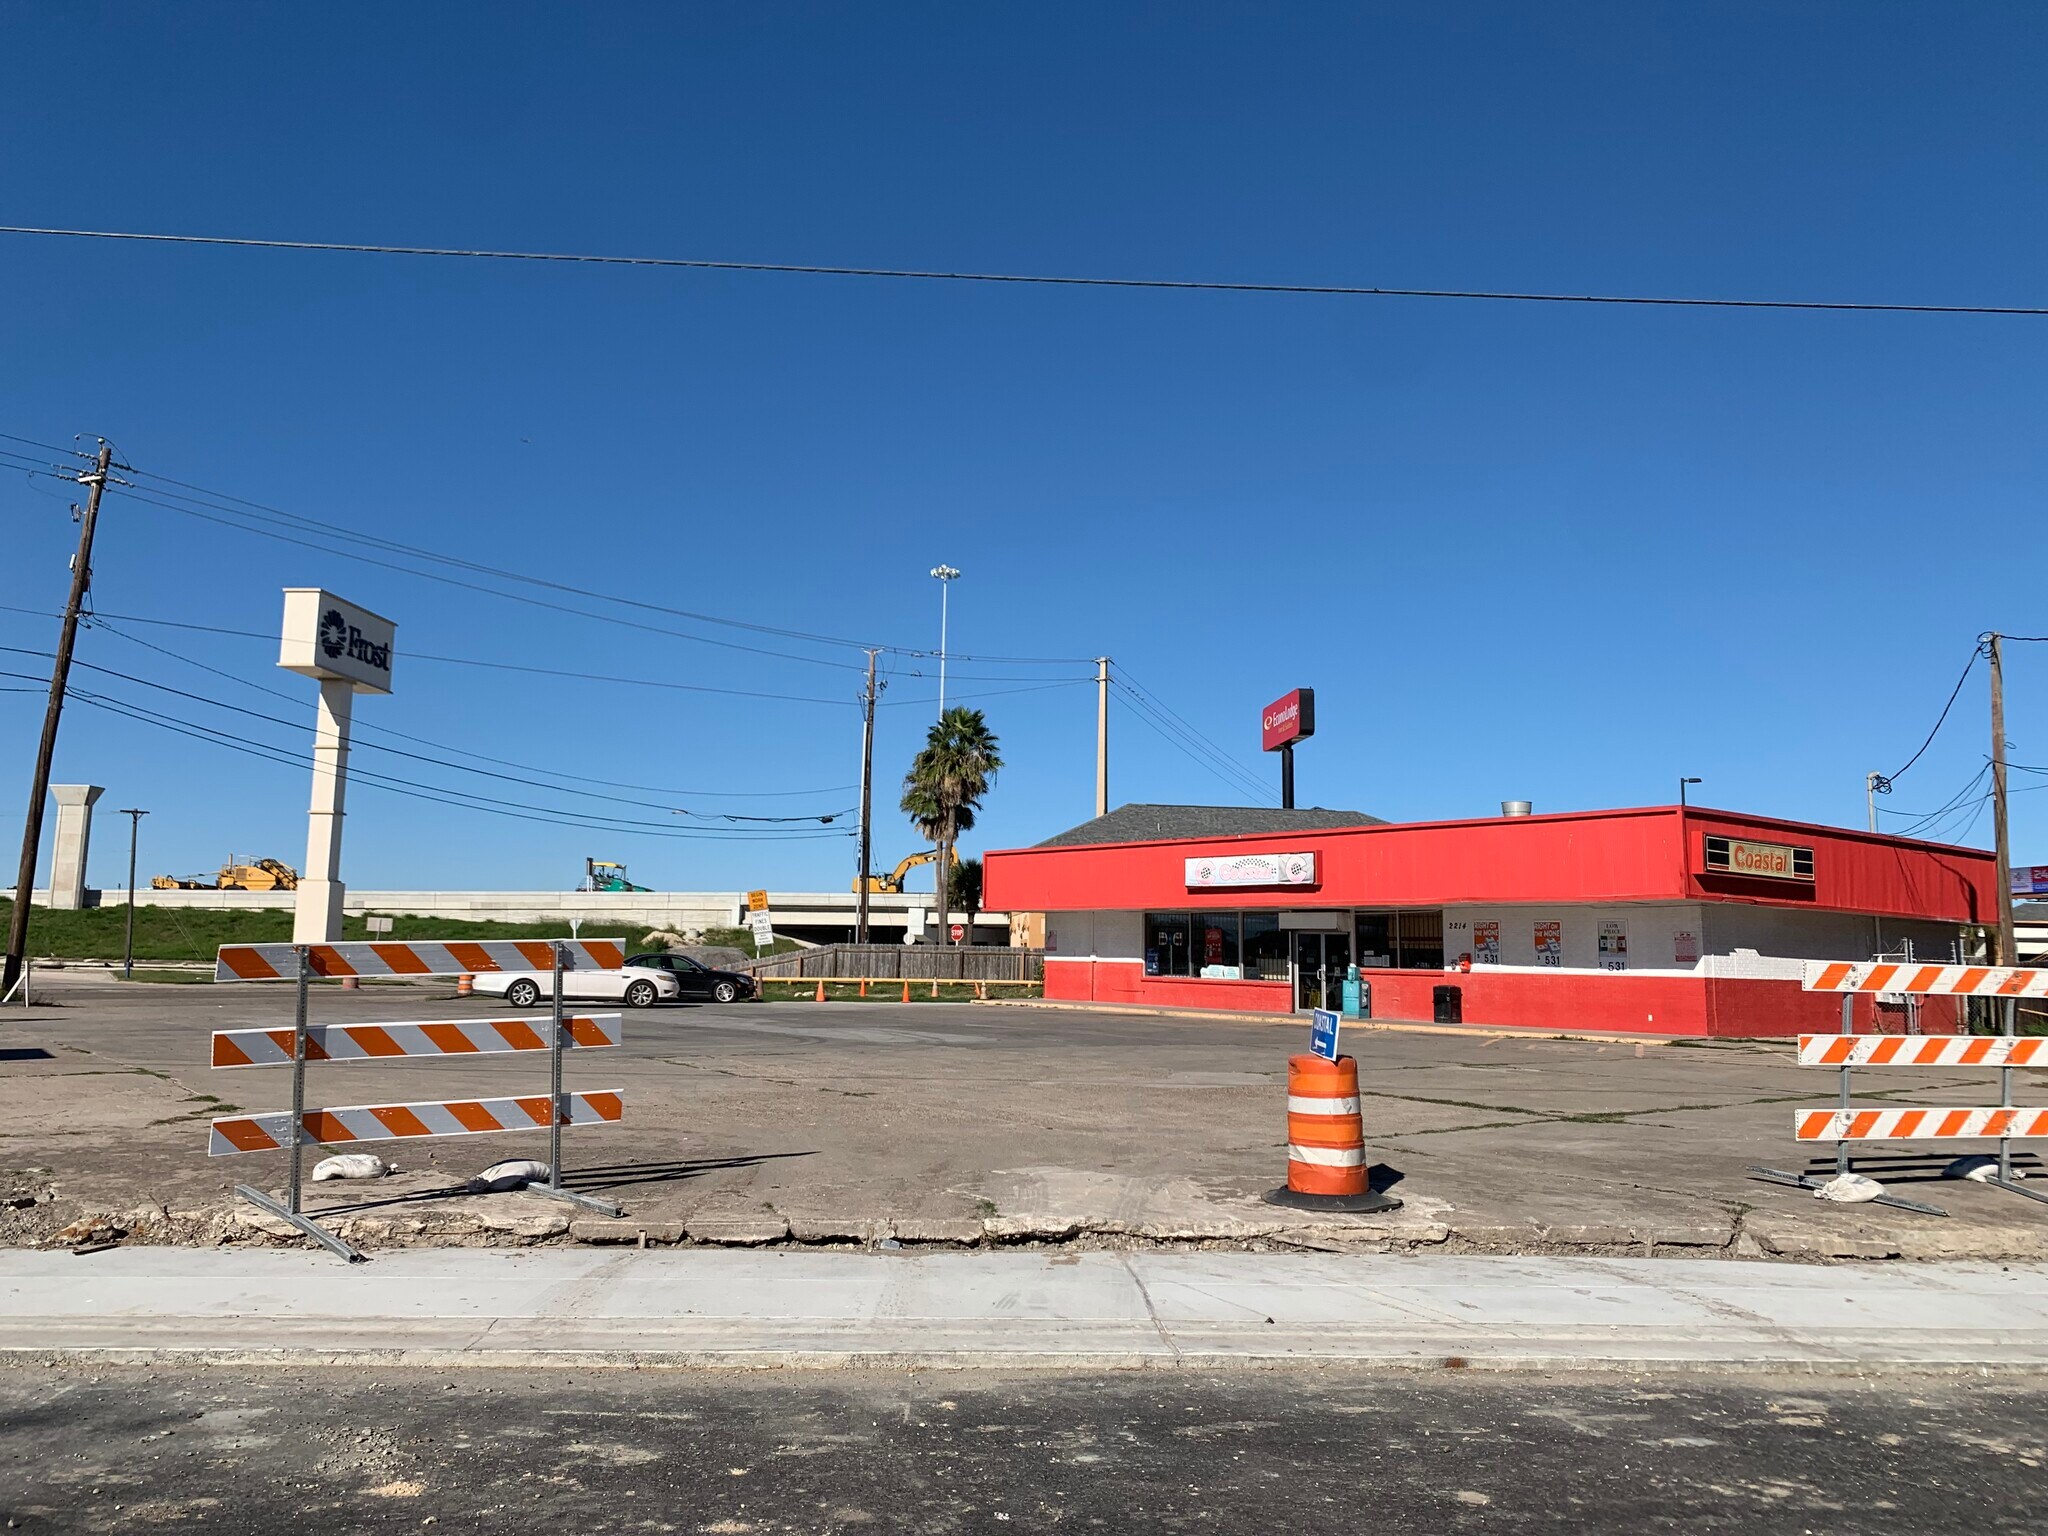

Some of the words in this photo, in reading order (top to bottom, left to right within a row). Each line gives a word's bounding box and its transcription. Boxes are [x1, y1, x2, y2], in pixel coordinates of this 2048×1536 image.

[346, 625, 391, 671] Frost
[1734, 844, 1787, 872] Coastal
[1449, 922, 1467, 930] 2214
[1484, 954, 1498, 963] 531
[1545, 955, 1560, 965] 531
[1608, 961, 1625, 971] 531
[1314, 1013, 1333, 1035] COASTAL
